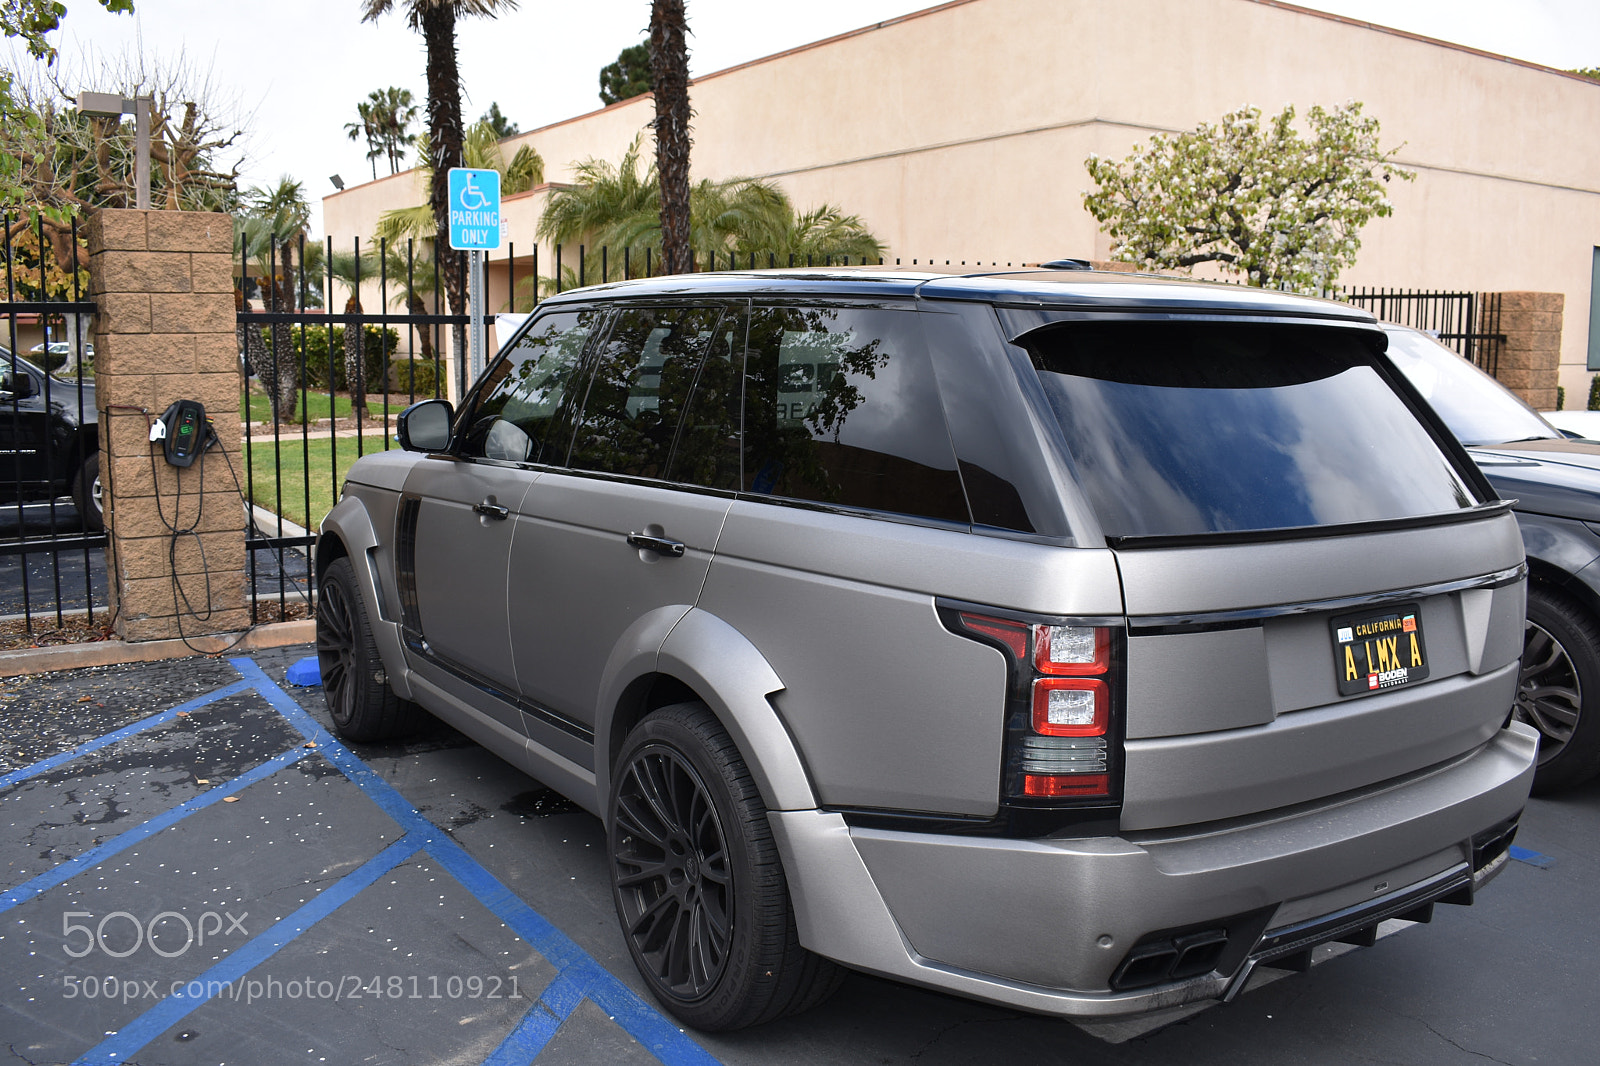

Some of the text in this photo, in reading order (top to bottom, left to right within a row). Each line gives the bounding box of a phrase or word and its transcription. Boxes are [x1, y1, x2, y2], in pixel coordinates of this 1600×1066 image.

[452, 210, 498, 226] PARKING
[462, 229, 488, 244] ONLY
[1356, 618, 1402, 636] CALIFORNIA
[1345, 632, 1422, 681] A LMX A
[1378, 667, 1408, 682] BODEN
